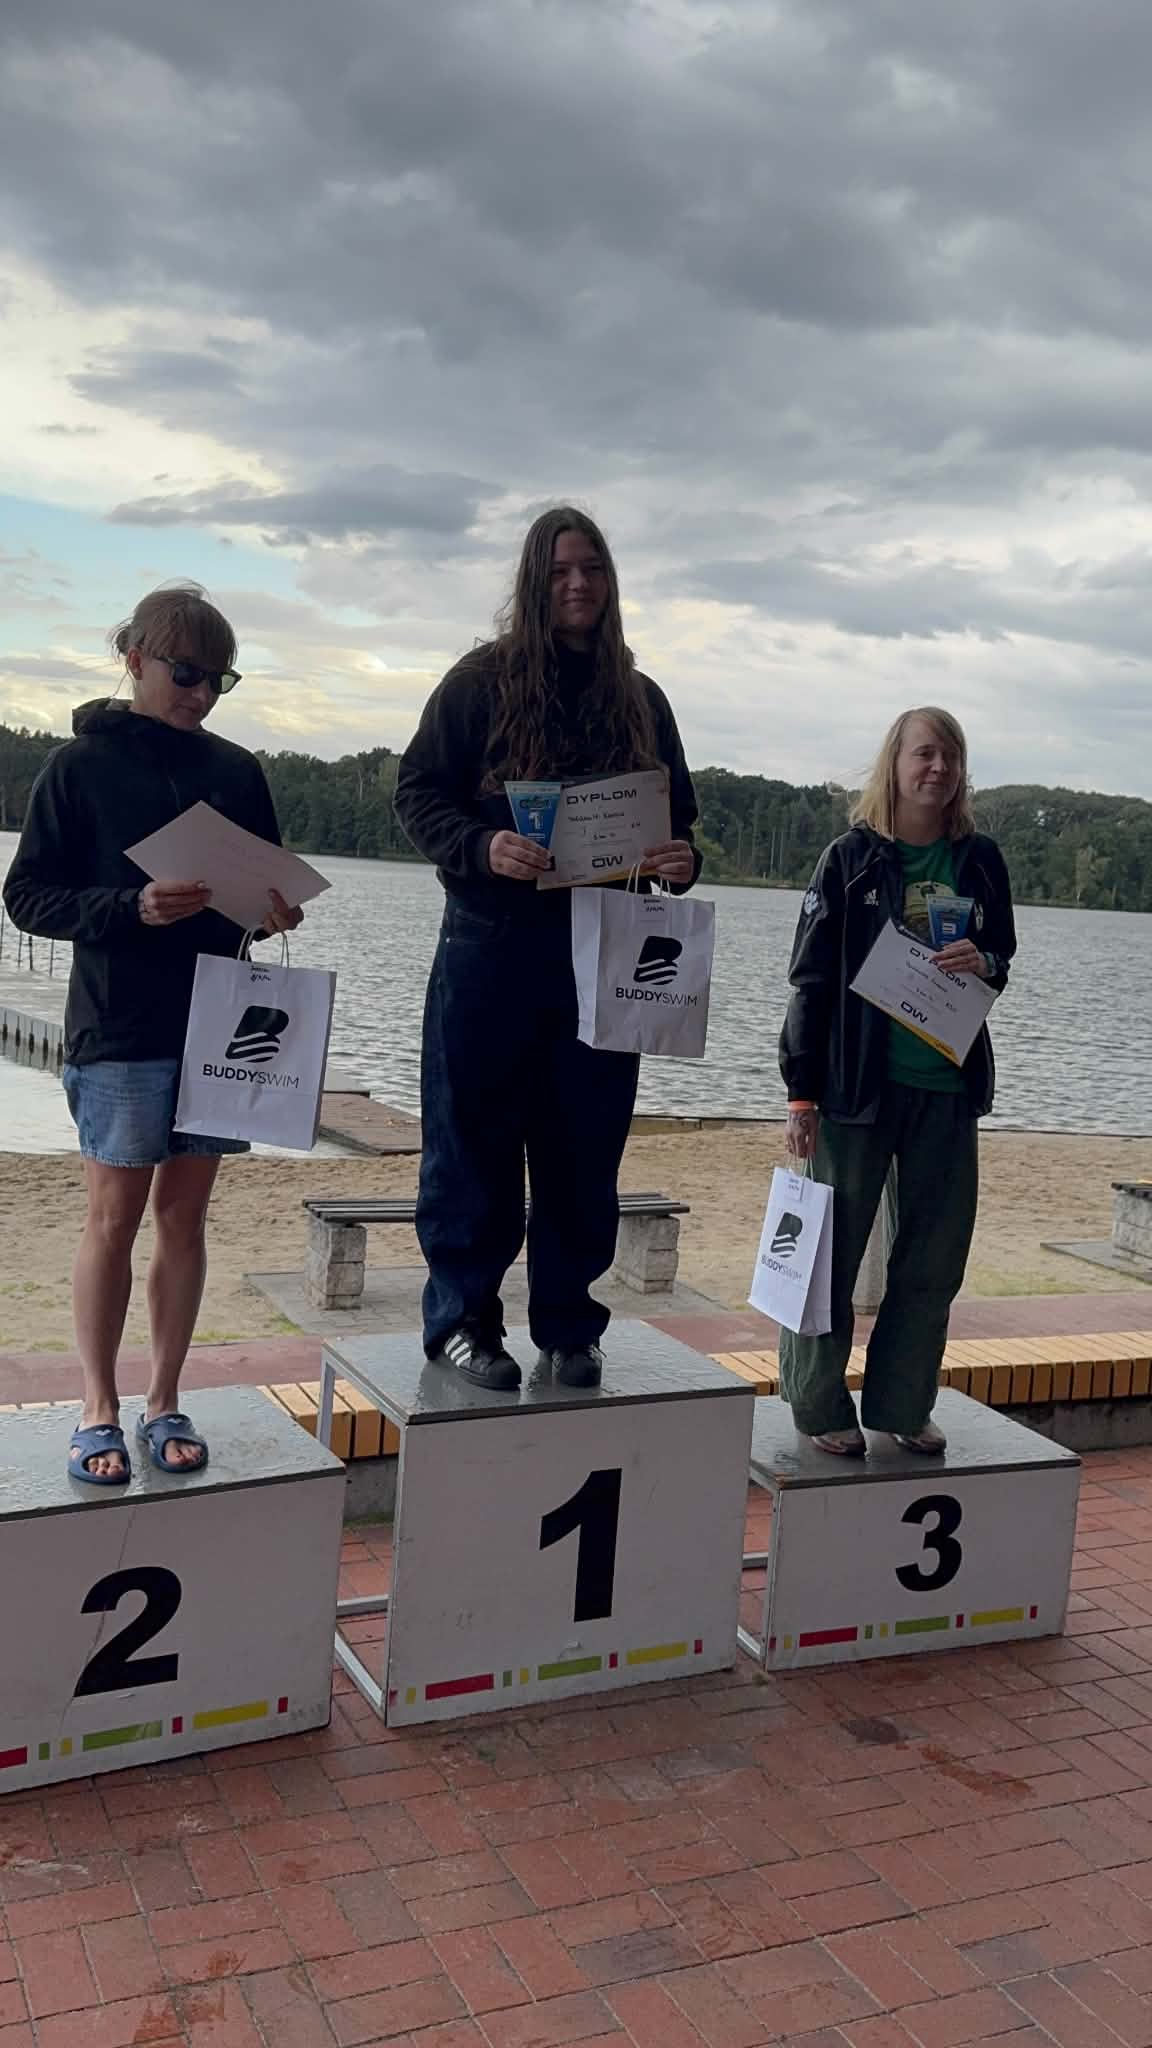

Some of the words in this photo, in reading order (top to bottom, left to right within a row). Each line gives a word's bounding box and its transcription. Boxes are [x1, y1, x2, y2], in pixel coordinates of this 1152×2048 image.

[566, 789, 637, 805] DYPLOM
[592, 856, 623, 868] OW
[616, 987, 697, 1006] BUDDYSWIM
[901, 1000, 928, 1023] OW
[203, 1063, 299, 1088] BUDDYSWIM
[539, 1467, 622, 1622] 1
[896, 1494, 963, 1592] 3
[75, 1566, 182, 1697] 2
